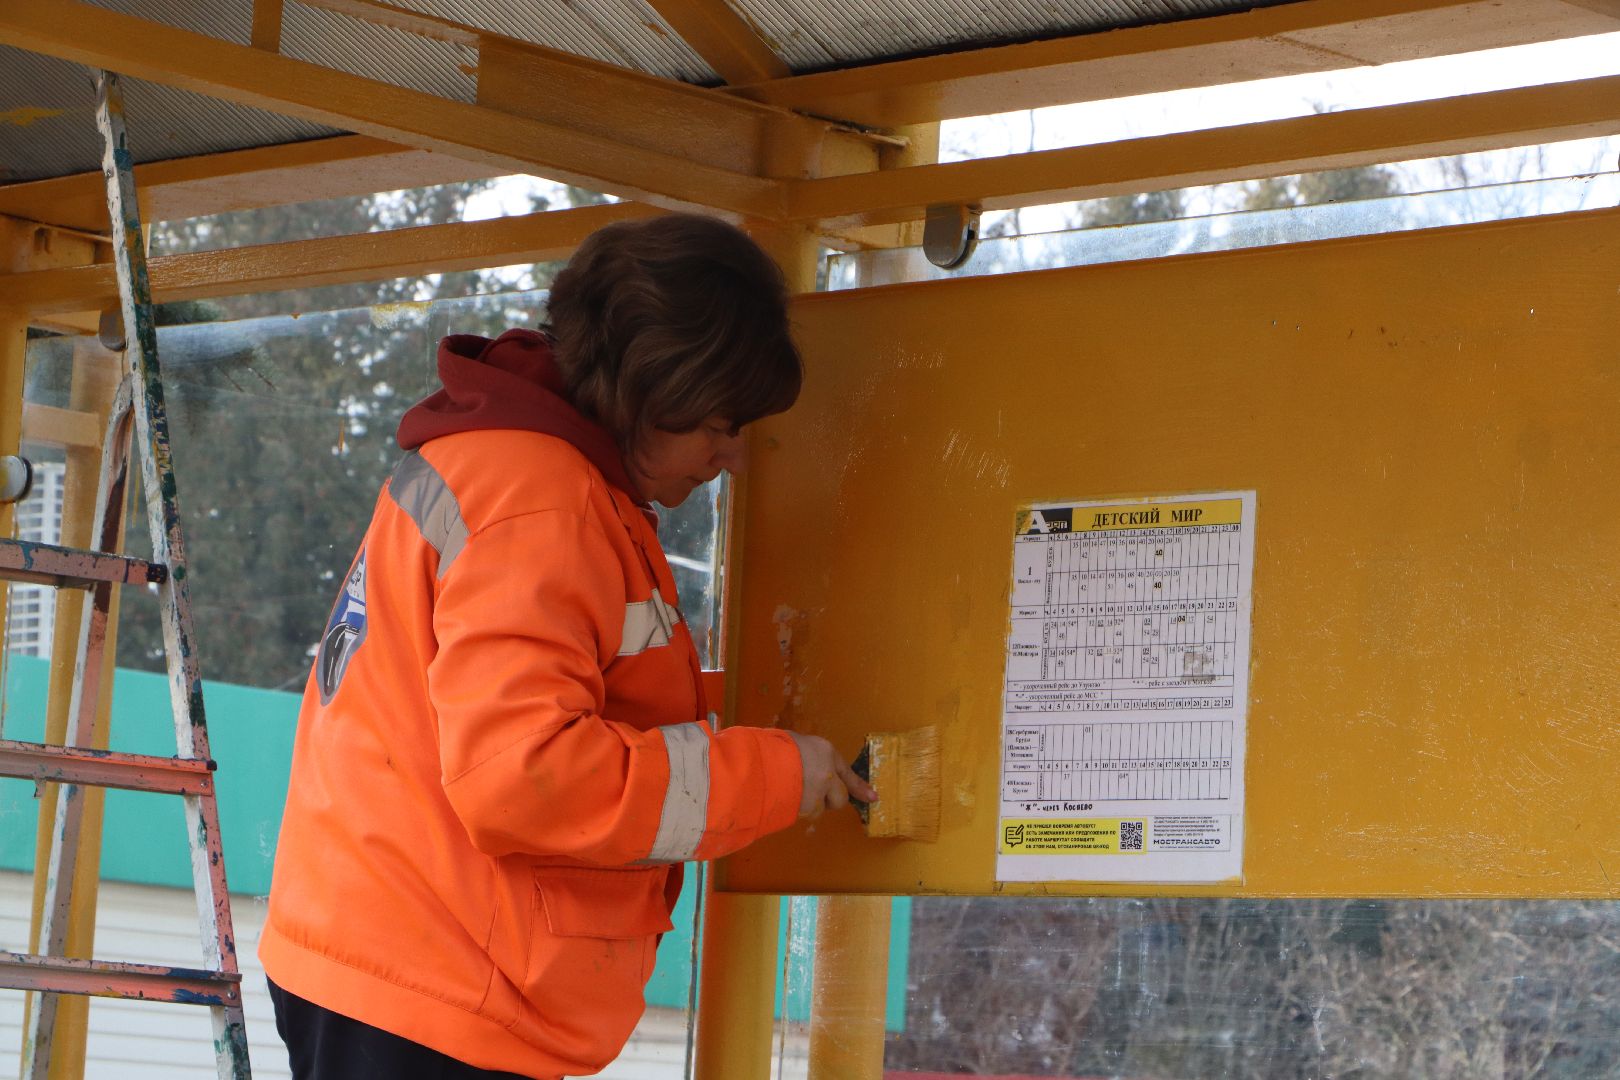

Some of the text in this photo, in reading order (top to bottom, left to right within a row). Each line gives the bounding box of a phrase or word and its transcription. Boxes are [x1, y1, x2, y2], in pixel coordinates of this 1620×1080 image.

[1092, 508, 1202, 528] ДЕТСКИЙ МИР
[1028, 566, 1032, 575] 1
[1064, 693, 1076, 701] рейс
